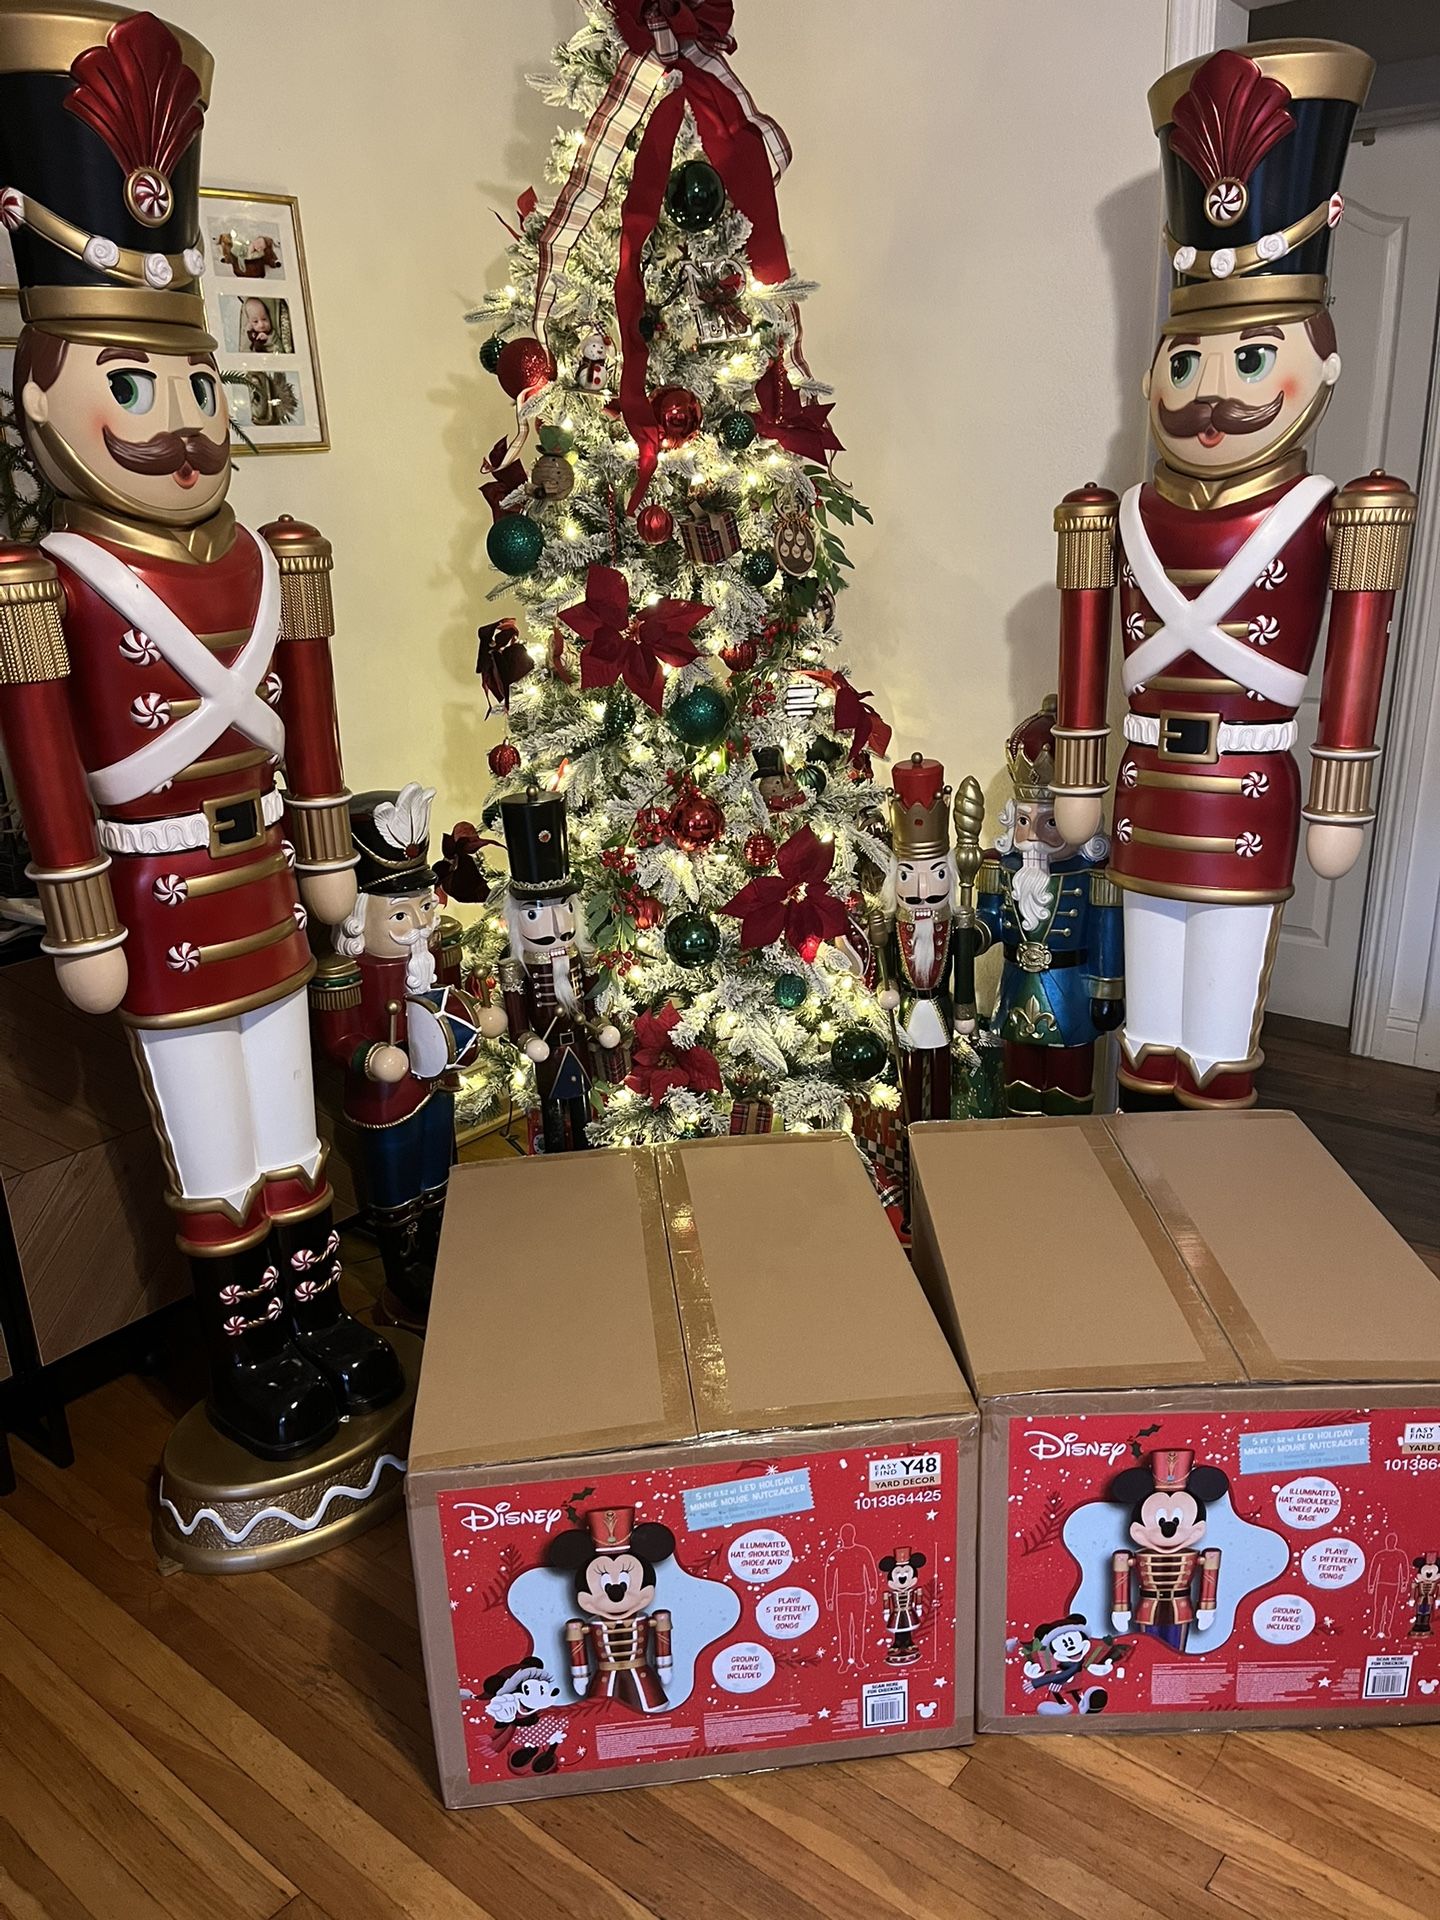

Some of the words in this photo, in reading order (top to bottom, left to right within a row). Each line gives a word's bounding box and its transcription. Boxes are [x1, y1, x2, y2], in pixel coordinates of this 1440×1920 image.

[1252, 1437, 1259, 1446] 5
[1297, 1432, 1314, 1441] LED
[1317, 1429, 1354, 1439] HOLIDAY
[1243, 1445, 1275, 1455] MICKEY
[1277, 1441, 1306, 1453] MOUSE
[1309, 1437, 1366, 1450] NUTCRACKER
[900, 1457, 937, 1475] Y48
[1384, 1458, 1440, 1471] 101386
[874, 1469, 898, 1477] FIND
[875, 1481, 900, 1489] YARD
[902, 1476, 935, 1486] DECOR
[695, 1491, 702, 1501] 5
[739, 1483, 757, 1493] LED
[759, 1475, 796, 1490] HOLIDAY
[1289, 1488, 1336, 1497] ILLUMINATED
[689, 1499, 719, 1512] MINNIE
[720, 1493, 750, 1506] MOUSE
[752, 1483, 806, 1501] NUTCRACKER
[854, 1490, 942, 1511] 1013864425
[1288, 1505, 1313, 1513] KNEES
[1313, 1506, 1330, 1514] AND
[1297, 1514, 1317, 1522] BASE
[740, 1541, 786, 1550] ILLUMINATED
[766, 1558, 783, 1566] AND
[1319, 1555, 1358, 1564] DIFFERENT
[751, 1567, 770, 1575] BASE
[1317, 1564, 1347, 1572] FESTIVE
[1318, 1572, 1344, 1580] SONGS
[778, 1596, 801, 1604] PLAYS
[773, 1604, 811, 1613] DIFFERENT
[1272, 1607, 1302, 1615] GROUND
[773, 1613, 802, 1622] FESTIVE
[1271, 1615, 1300, 1623] STAKES
[775, 1622, 800, 1630] SONGS
[1266, 1623, 1301, 1631] INCLUDED
[730, 1655, 760, 1664] GROUND
[730, 1663, 759, 1672] STAKES
[727, 1671, 762, 1680] INCLUDED
